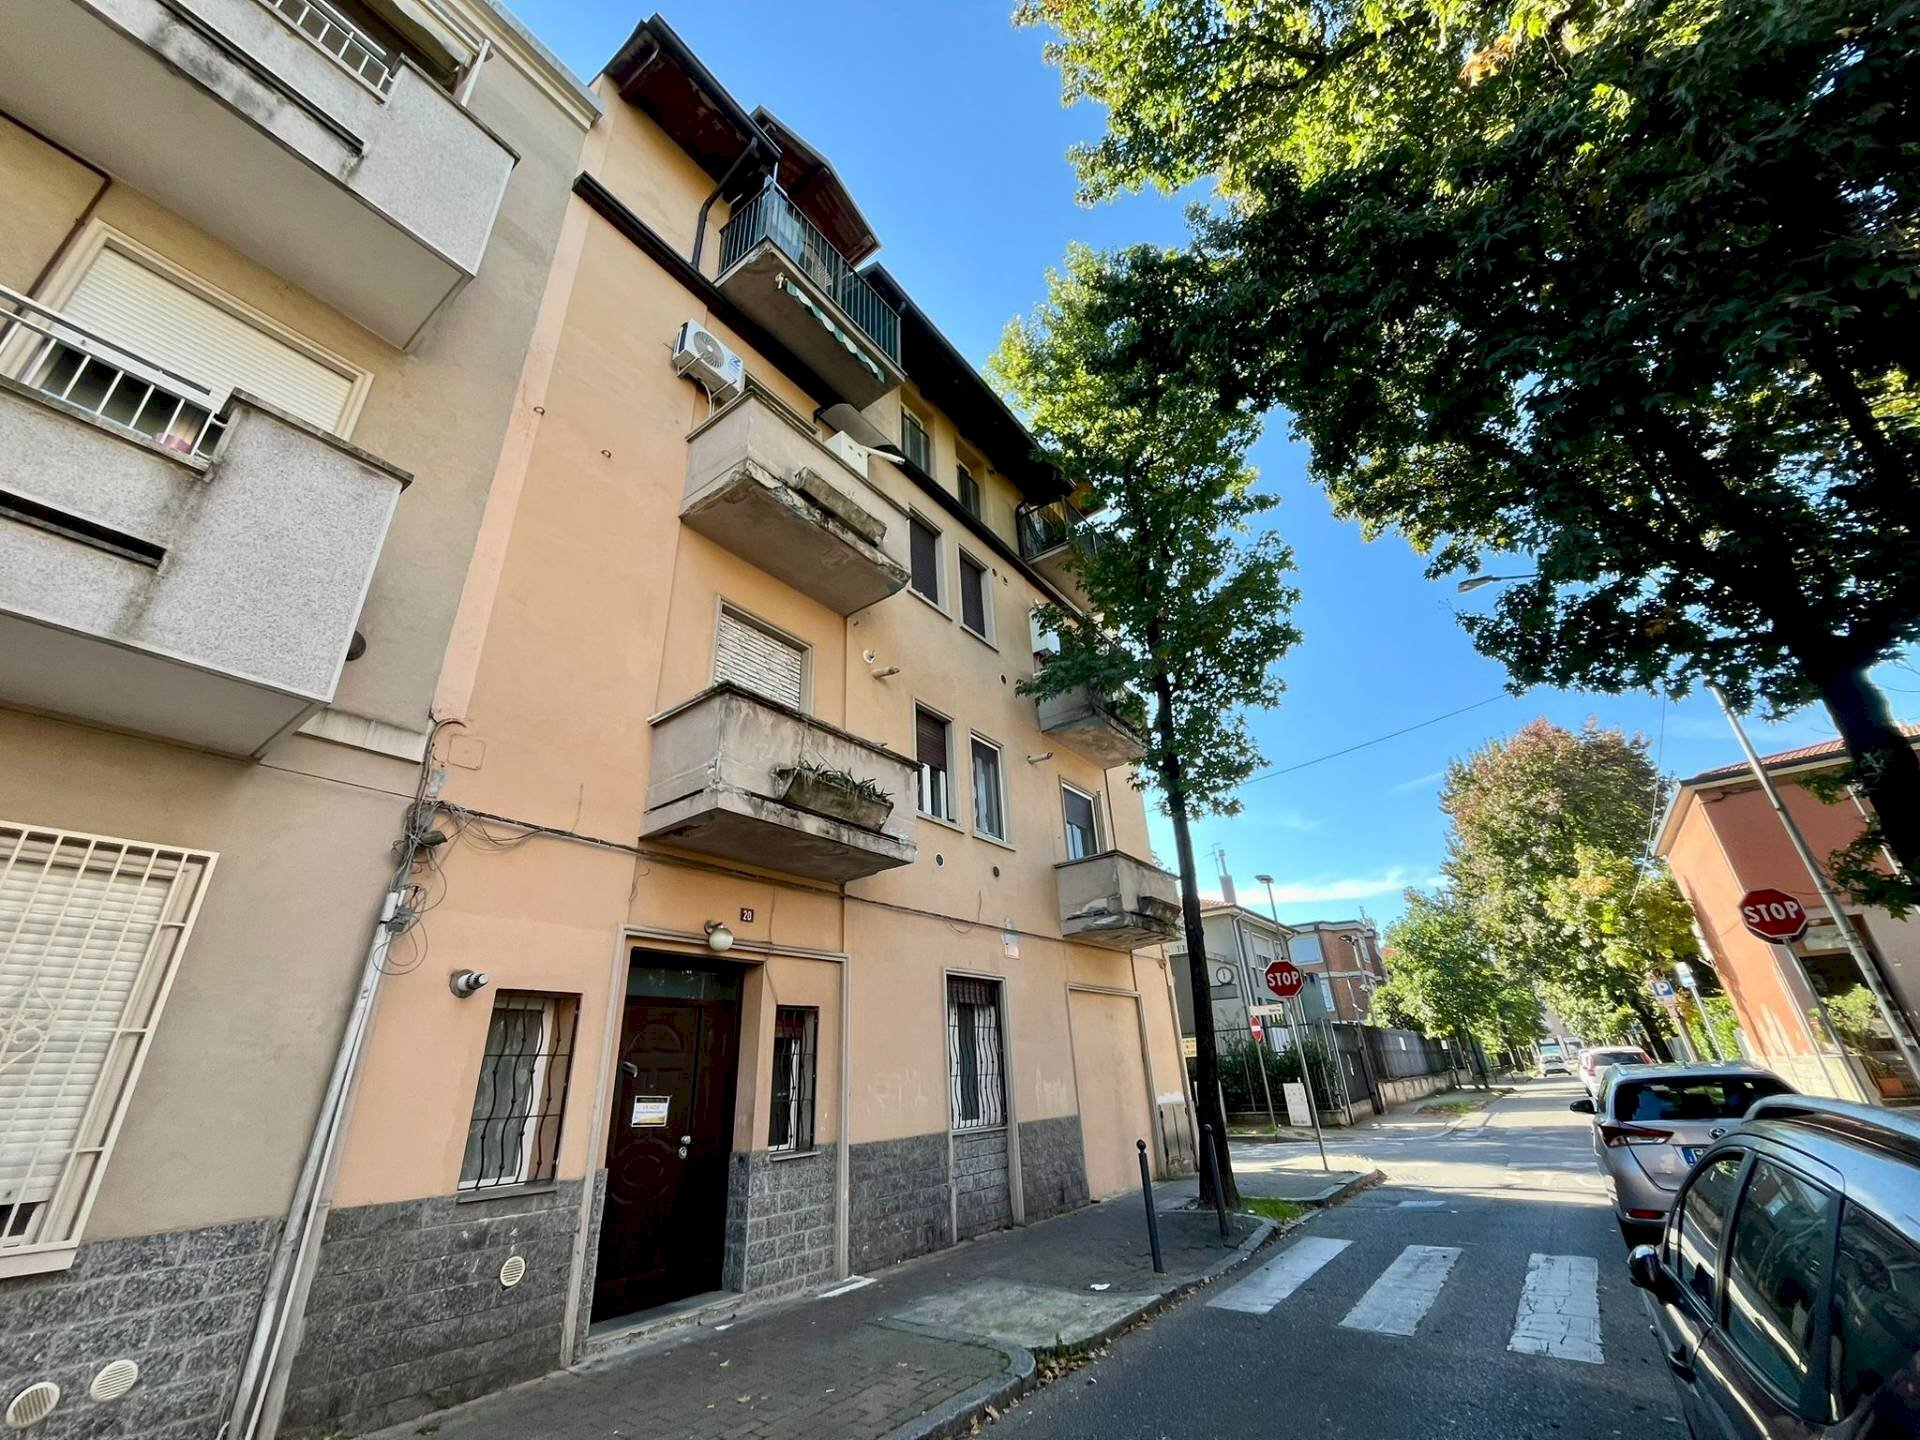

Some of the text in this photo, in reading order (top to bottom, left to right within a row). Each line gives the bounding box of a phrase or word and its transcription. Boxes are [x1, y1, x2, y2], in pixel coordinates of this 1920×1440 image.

[743, 910, 752, 921] 20
[1743, 901, 1798, 923] STOP
[1267, 971, 1299, 987] STOP
[1655, 982, 1669, 995] P
